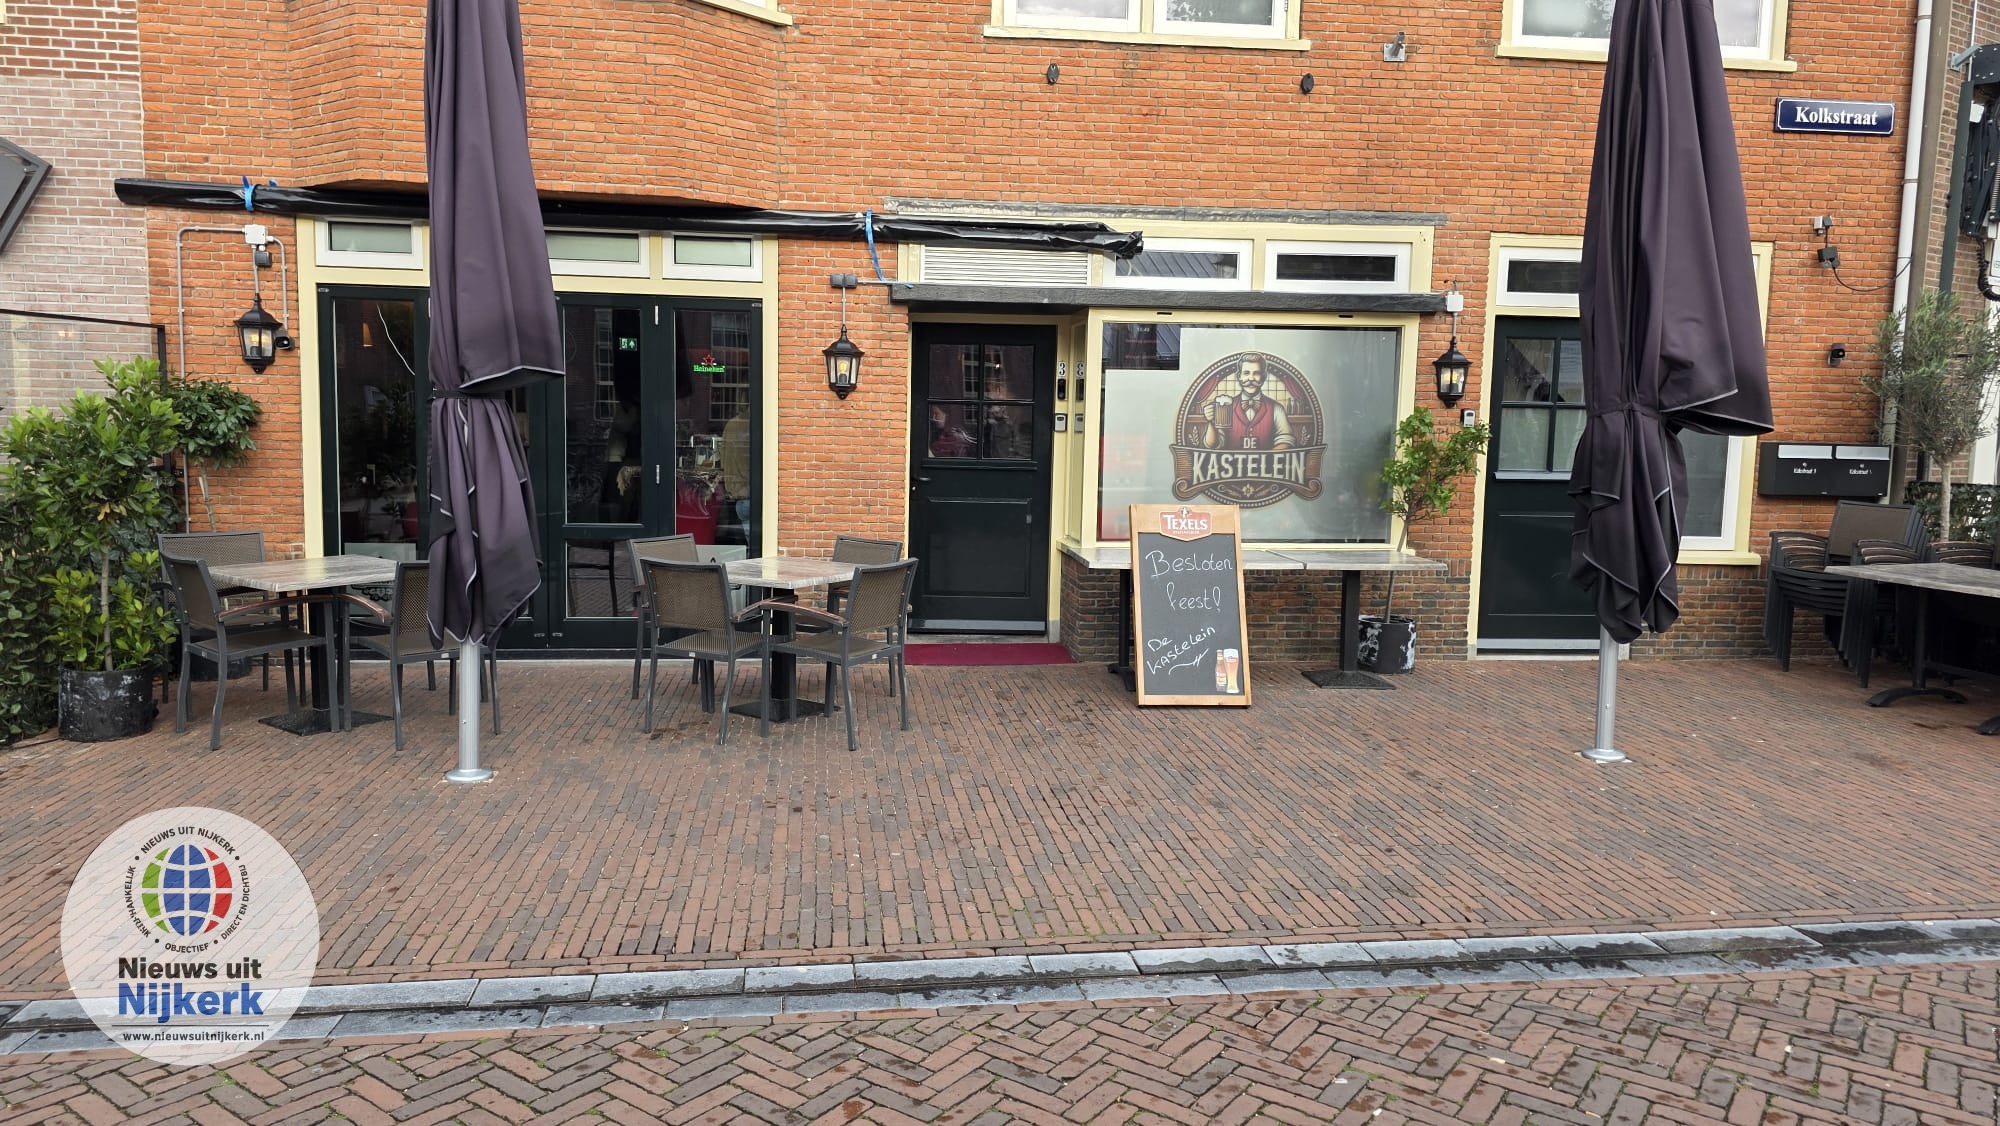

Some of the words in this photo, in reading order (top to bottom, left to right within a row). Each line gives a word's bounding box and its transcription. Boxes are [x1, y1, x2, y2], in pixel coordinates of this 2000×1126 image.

[1795, 106, 1878, 125] Kolkstraat
[1059, 362, 1066, 376] 3
[1243, 437, 1257, 449] DE
[1192, 452, 1306, 485] KASTELEIN
[1145, 550, 1233, 577] Besloten
[1147, 637, 1173, 652] De
